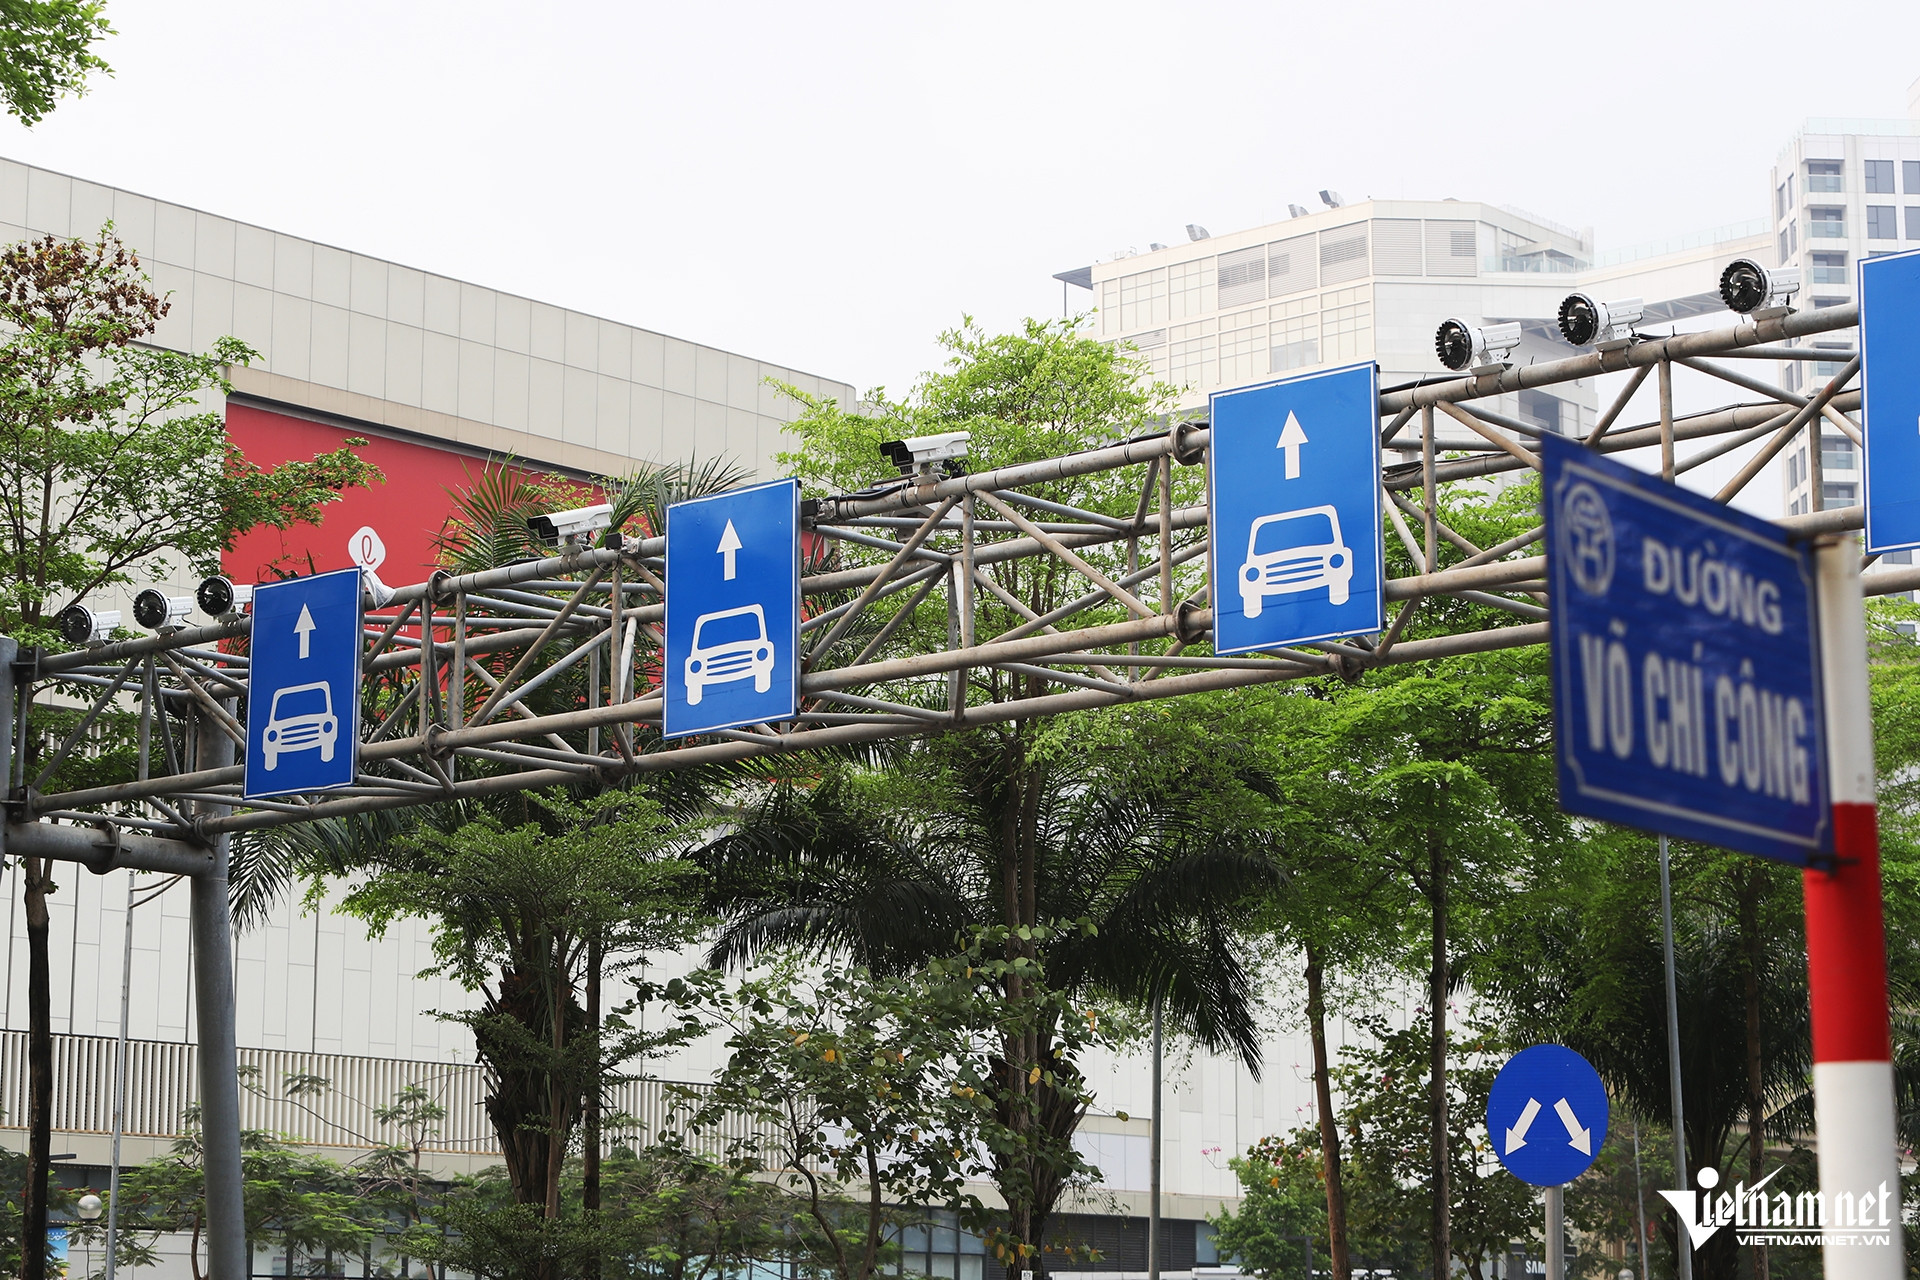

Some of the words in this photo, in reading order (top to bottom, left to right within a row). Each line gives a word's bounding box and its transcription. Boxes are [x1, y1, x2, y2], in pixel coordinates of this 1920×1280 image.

[1642, 536, 1783, 635] ĐƯỜNG
[1579, 617, 1634, 761] VÕ
[1643, 640, 1707, 778] CHÍ
[1714, 657, 1810, 804] CÔNG
